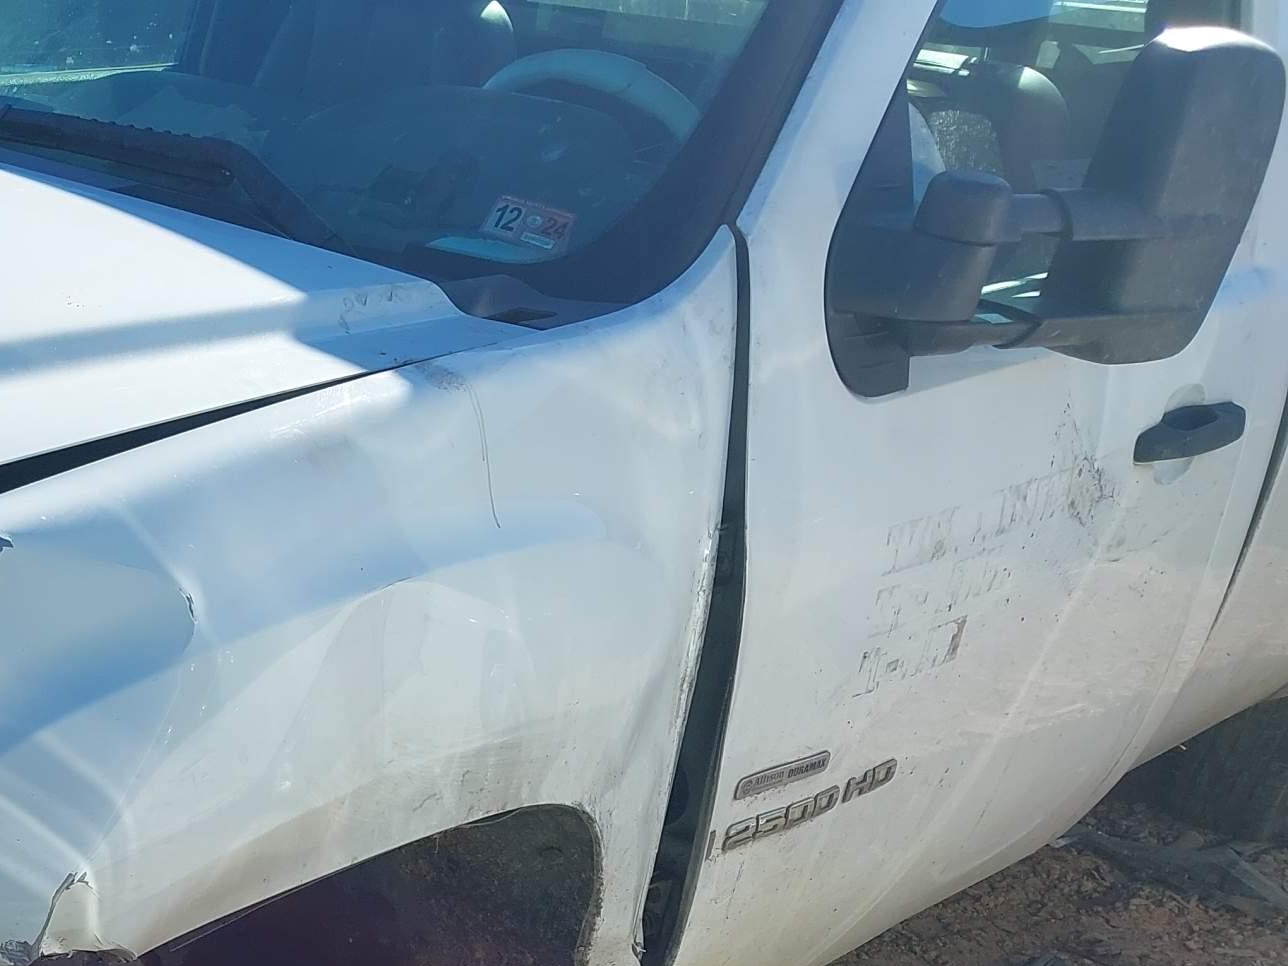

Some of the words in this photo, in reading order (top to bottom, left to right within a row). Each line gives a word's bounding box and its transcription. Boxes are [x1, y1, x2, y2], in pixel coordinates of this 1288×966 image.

[494, 204, 523, 231] 12
[787, 757, 828, 779] DURAMAX
[721, 784, 841, 852] 2500
[842, 757, 898, 804] HD
